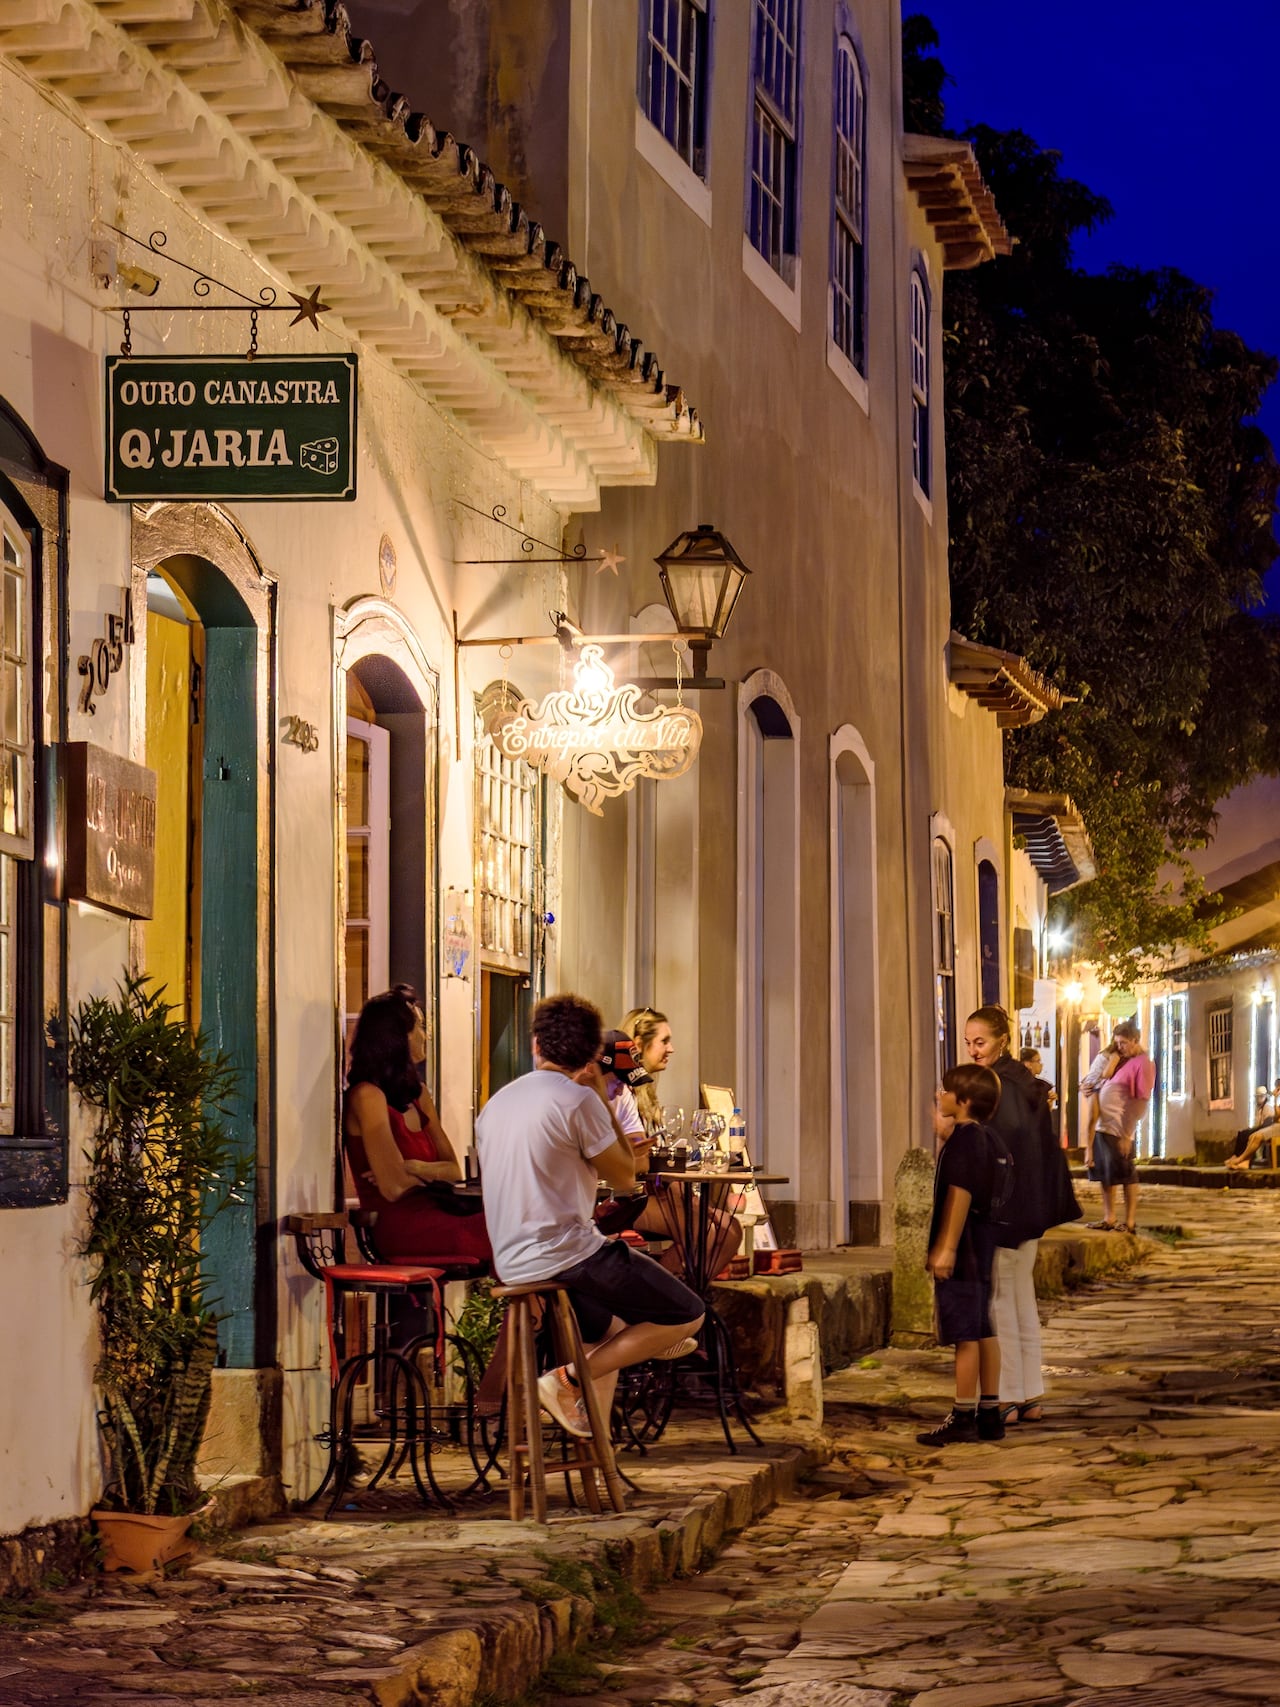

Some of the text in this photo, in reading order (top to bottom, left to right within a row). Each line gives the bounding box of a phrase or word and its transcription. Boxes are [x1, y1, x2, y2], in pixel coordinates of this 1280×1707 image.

[120, 380, 340, 406] OURO CANASTRA
[119, 428, 293, 470] Q'JARIA
[614, 724, 648, 748] du
[651, 716, 692, 748] Vin
